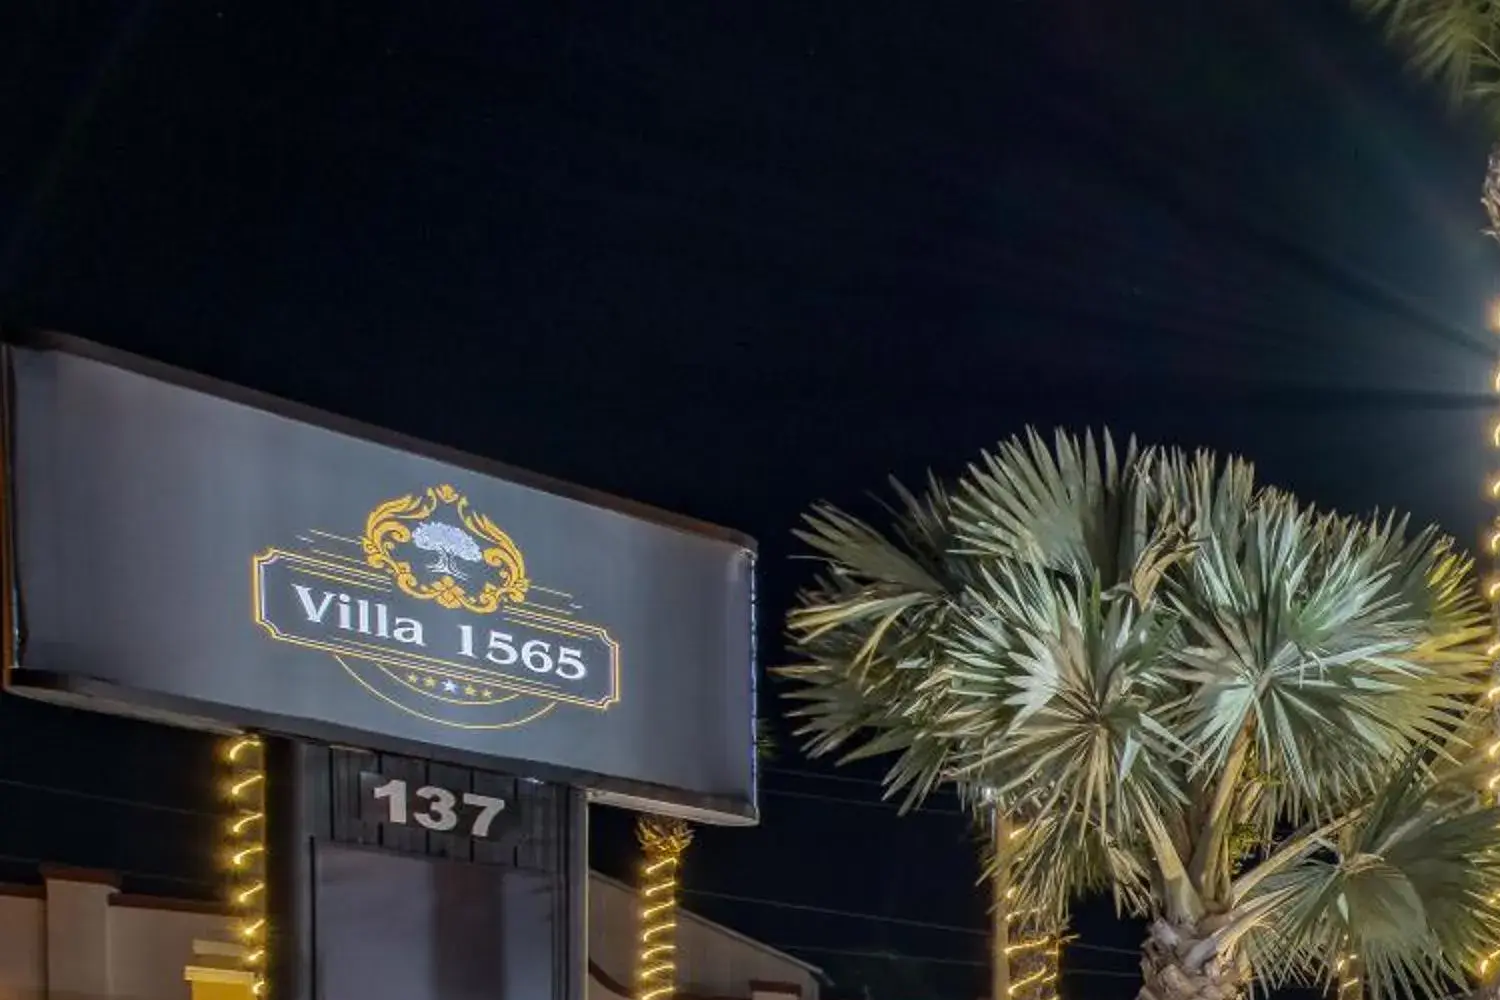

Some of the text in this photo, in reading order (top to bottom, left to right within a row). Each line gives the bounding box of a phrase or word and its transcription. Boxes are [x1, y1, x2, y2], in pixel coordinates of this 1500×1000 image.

[292, 583, 587, 680] Villa 1565
[373, 779, 506, 837] 137
